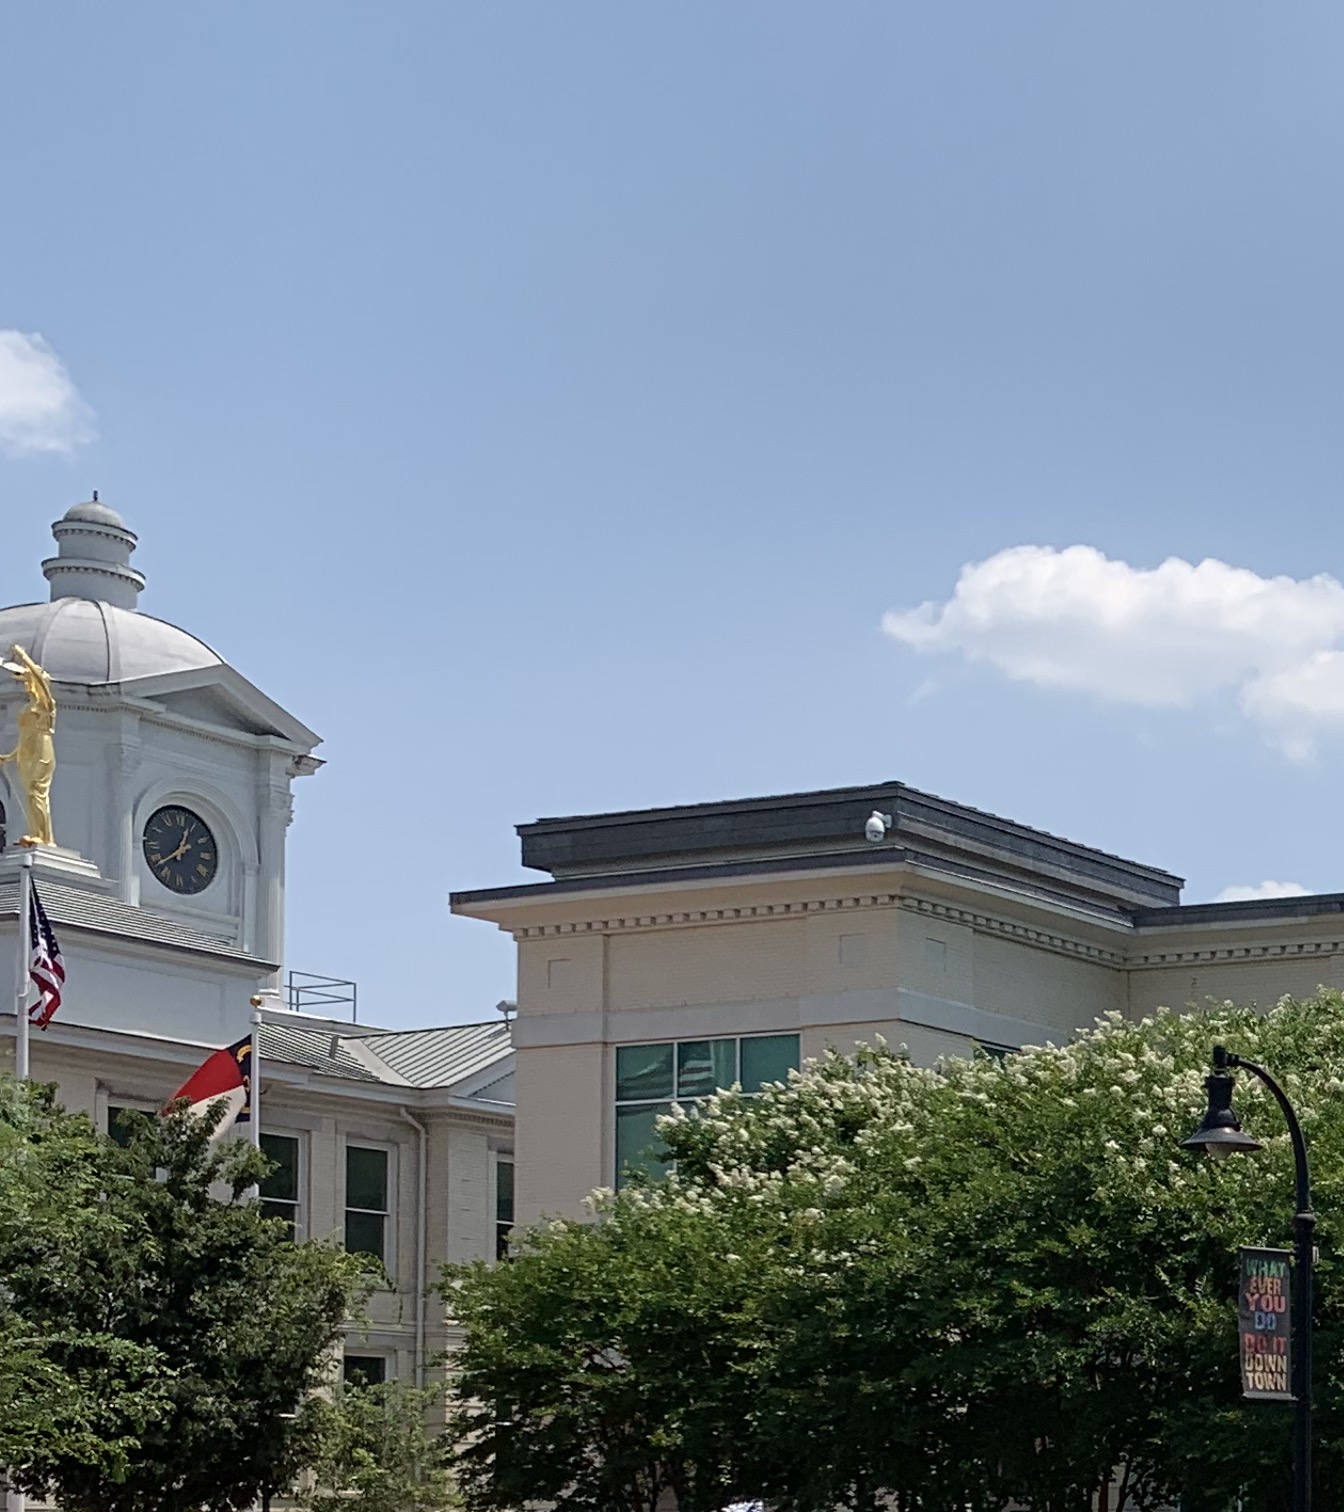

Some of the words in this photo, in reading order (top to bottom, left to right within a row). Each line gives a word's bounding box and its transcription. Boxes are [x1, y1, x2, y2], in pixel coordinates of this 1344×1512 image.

[1246, 1259, 1285, 1278] WHAT
[1249, 1276, 1281, 1295] EVER
[1245, 1292, 1286, 1313] YOU
[1254, 1311, 1277, 1330] DO
[1244, 1333, 1267, 1353] DO
[1272, 1336, 1287, 1354] IT
[1245, 1353, 1287, 1372] DOWN
[1246, 1371, 1287, 1391] TOWN
